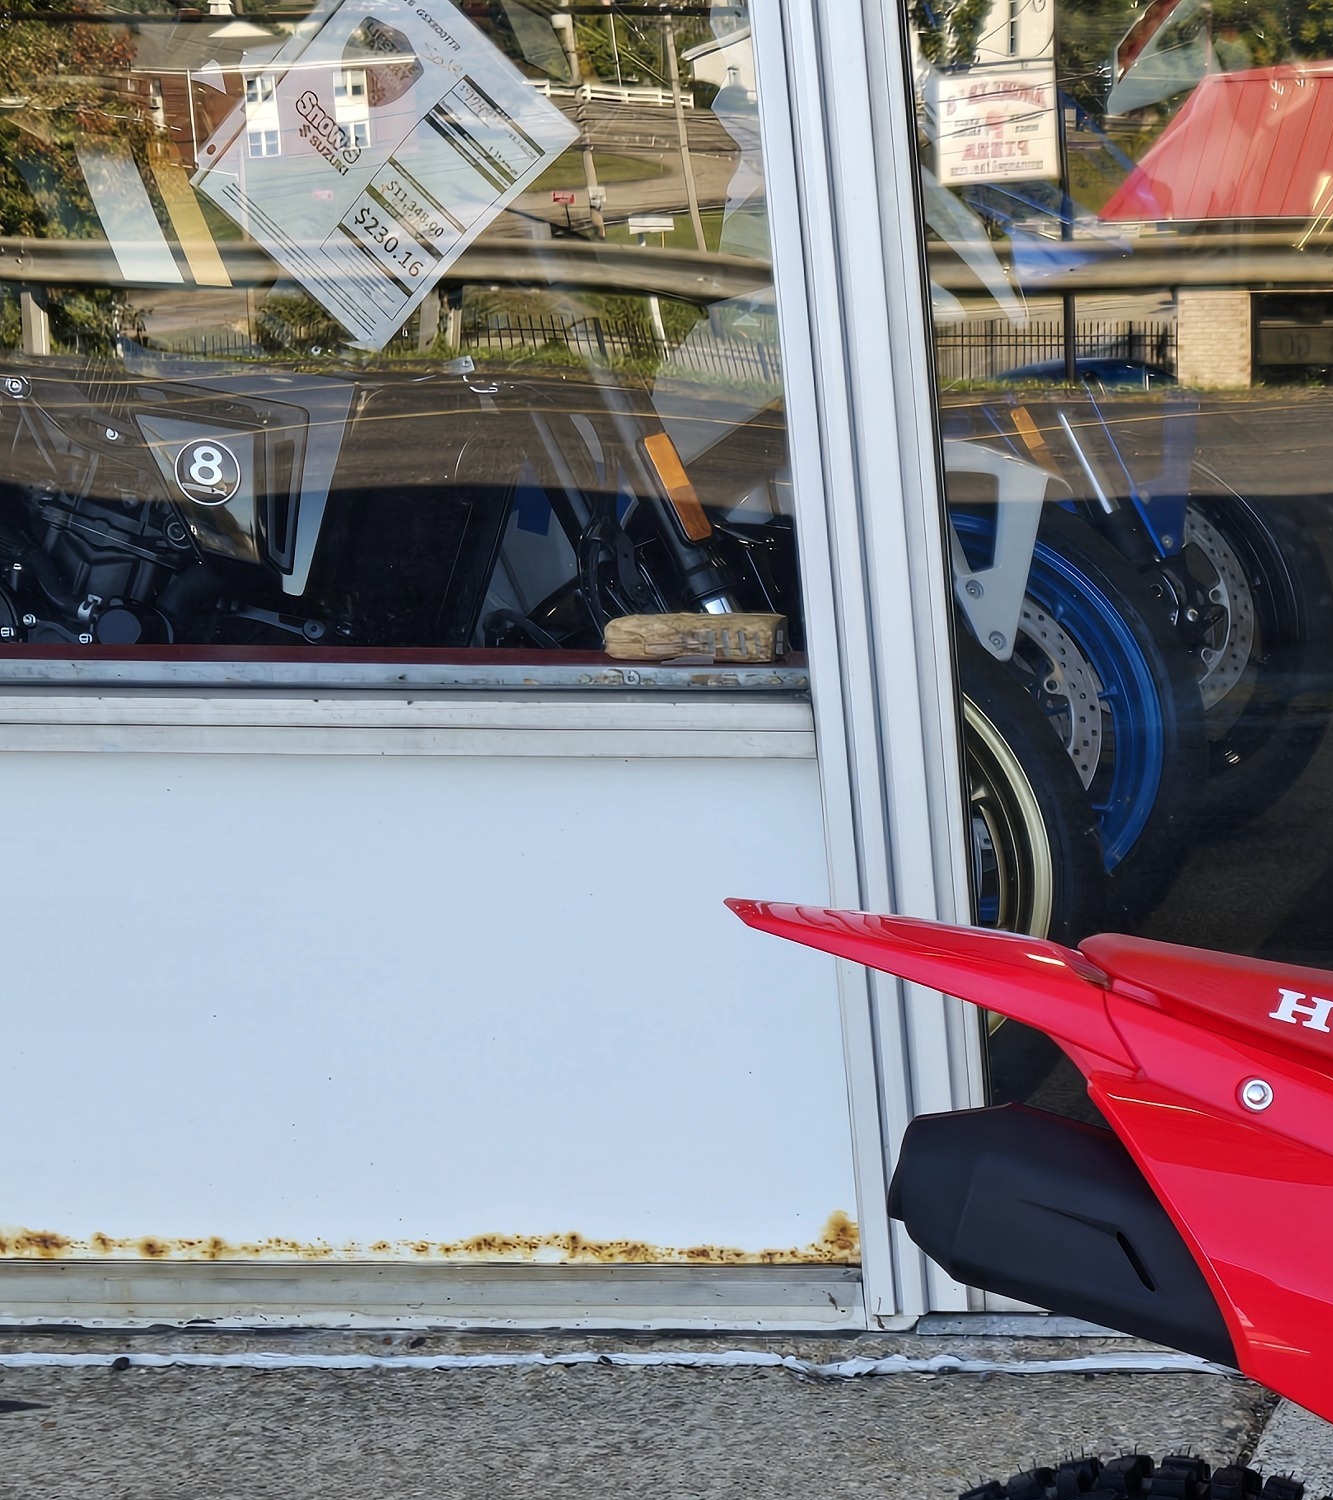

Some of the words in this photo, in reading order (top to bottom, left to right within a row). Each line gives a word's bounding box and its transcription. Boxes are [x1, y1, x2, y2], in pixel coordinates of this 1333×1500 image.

[309, 134, 350, 176] SUZUKI
[386, 180, 445, 239] $11,348.00
[353, 207, 424, 277] $230.16
[189, 445, 223, 486] 8
